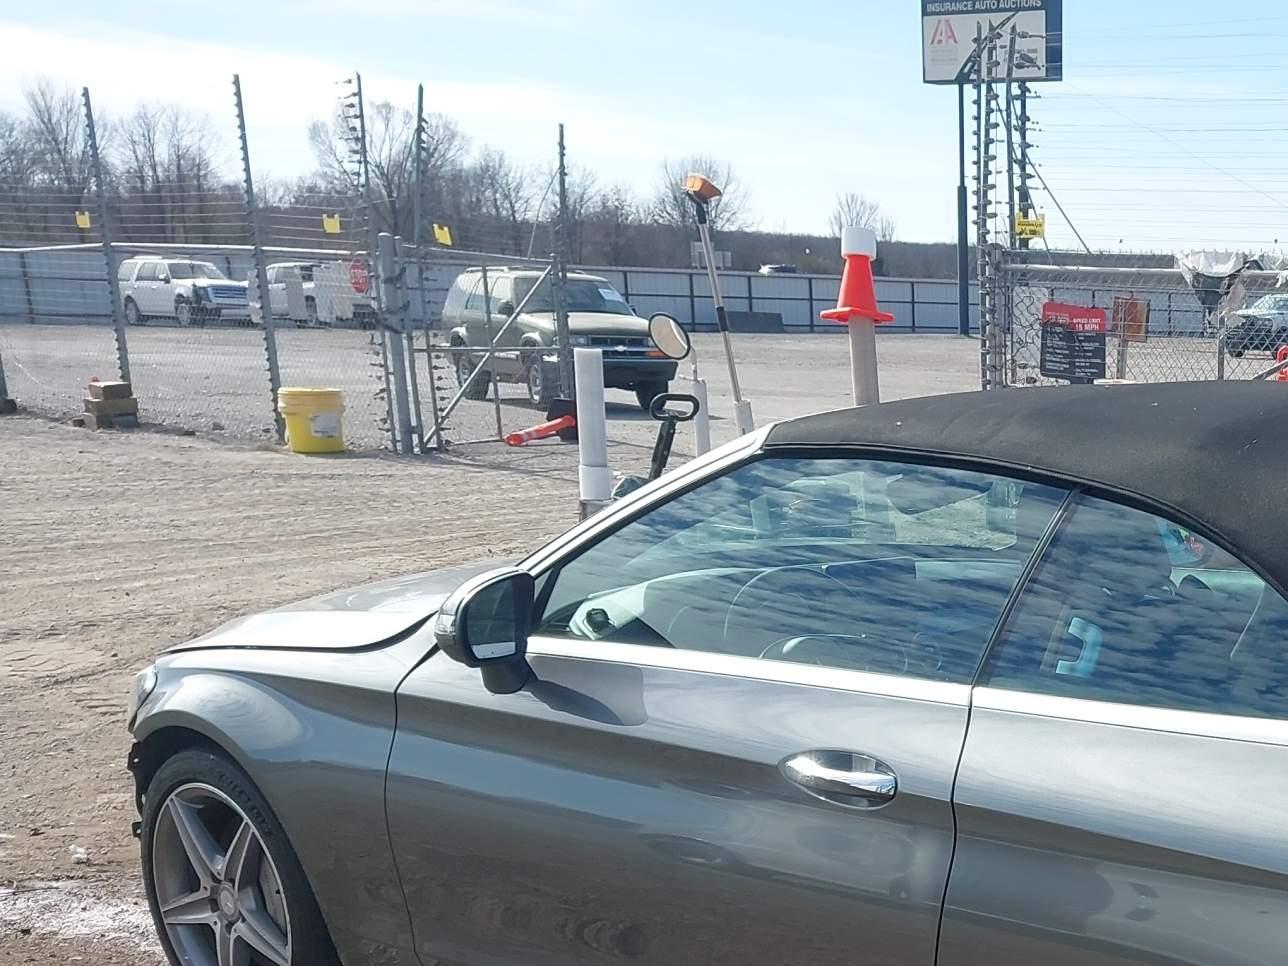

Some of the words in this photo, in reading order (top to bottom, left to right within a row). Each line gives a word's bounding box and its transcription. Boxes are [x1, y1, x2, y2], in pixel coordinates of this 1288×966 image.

[926, 1, 973, 13] INSURANCE
[974, 0, 998, 10] AUTO
[999, 0, 1042, 9] AUCTIONS
